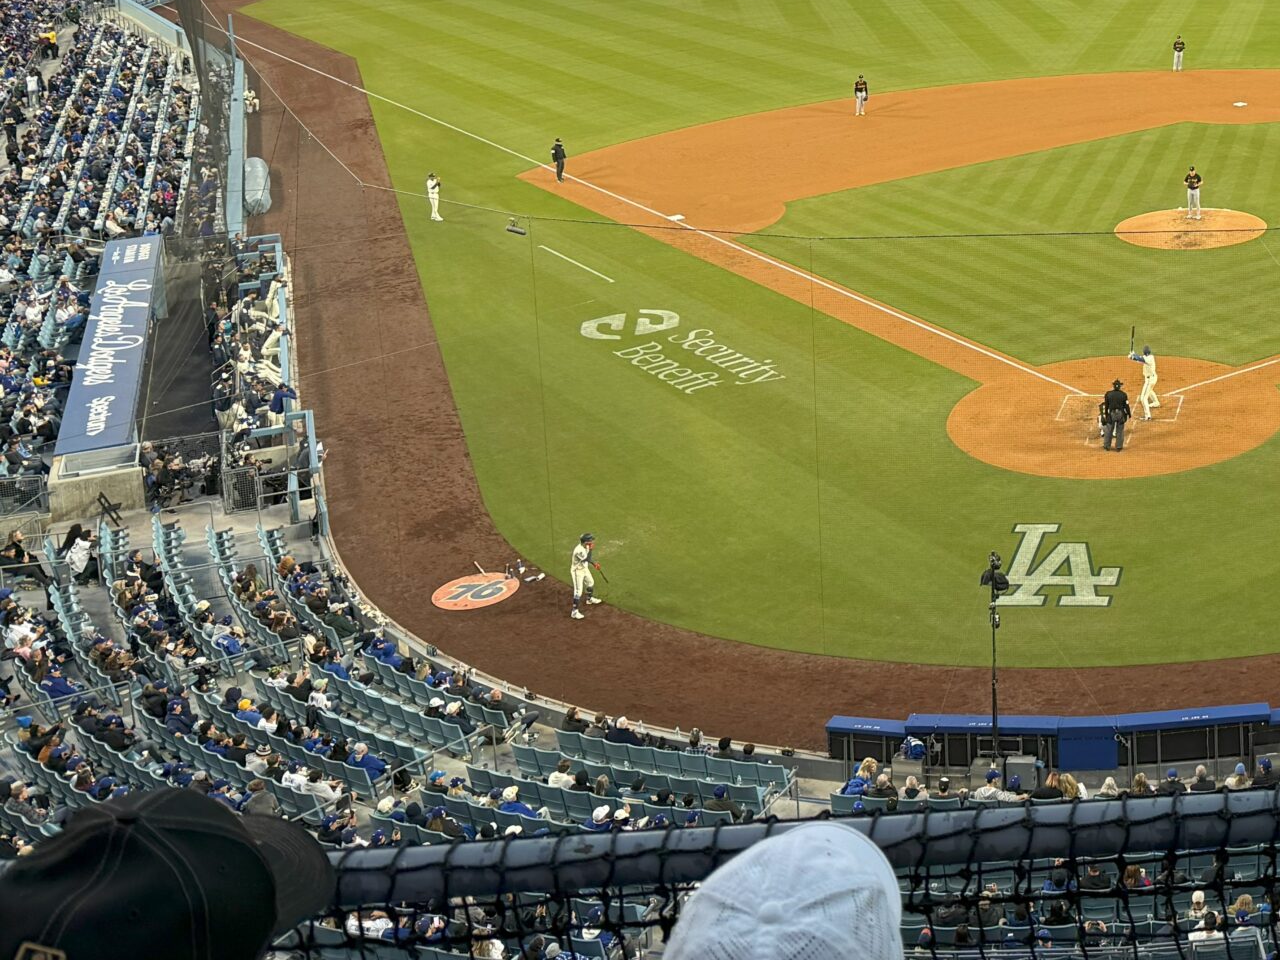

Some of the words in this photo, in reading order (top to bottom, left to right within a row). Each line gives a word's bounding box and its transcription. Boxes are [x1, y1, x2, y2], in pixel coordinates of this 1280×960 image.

[88, 296, 149, 338] Angeles
[76, 335, 143, 386] Dodgers
[612, 341, 723, 394] Benefit
[668, 328, 786, 385] Security
[86, 395, 116, 436] Spectrum
[442, 578, 507, 602] 76
[995, 523, 1124, 607] LA
